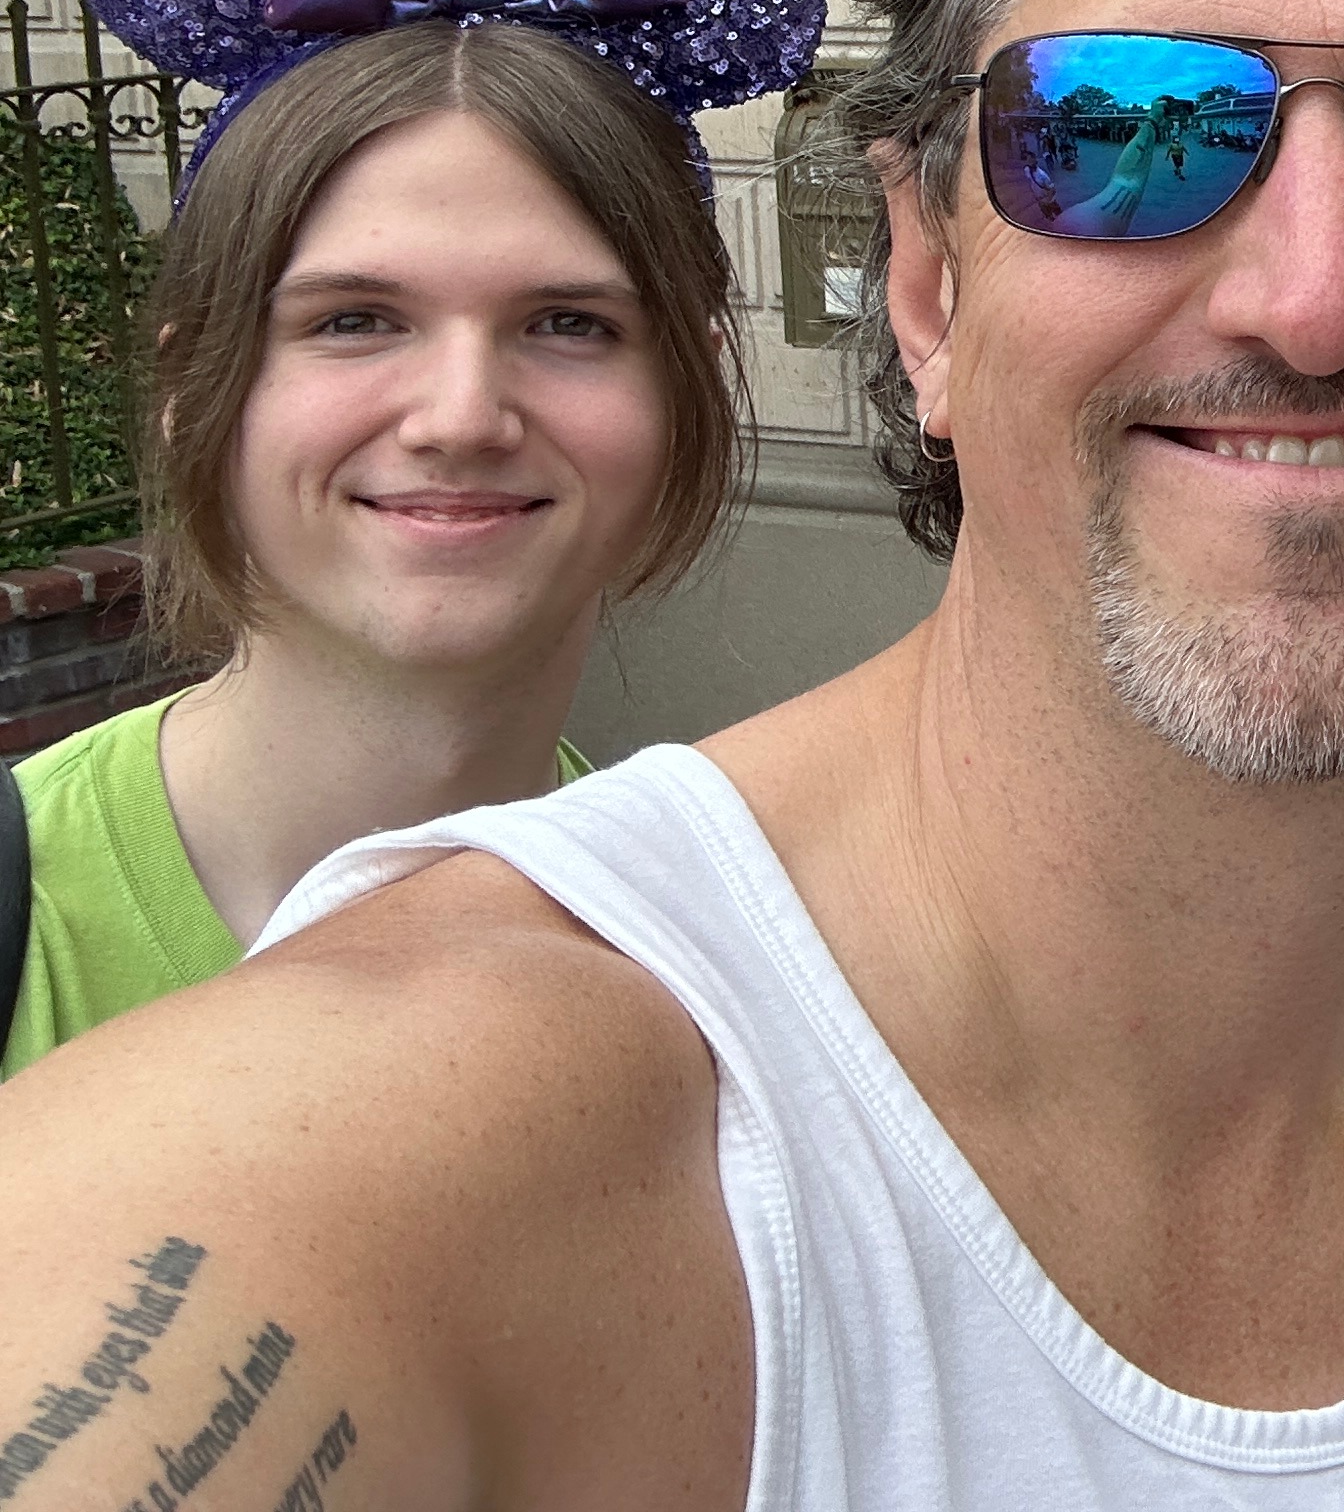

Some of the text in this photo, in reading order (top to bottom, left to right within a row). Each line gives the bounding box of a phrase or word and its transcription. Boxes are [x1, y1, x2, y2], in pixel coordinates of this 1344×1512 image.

[104, 1284, 186, 1338] that
[82, 1332, 151, 1393] eyes
[28, 1382, 112, 1440] with
[153, 1365, 262, 1496] diamond
[242, 1321, 296, 1396] mine
